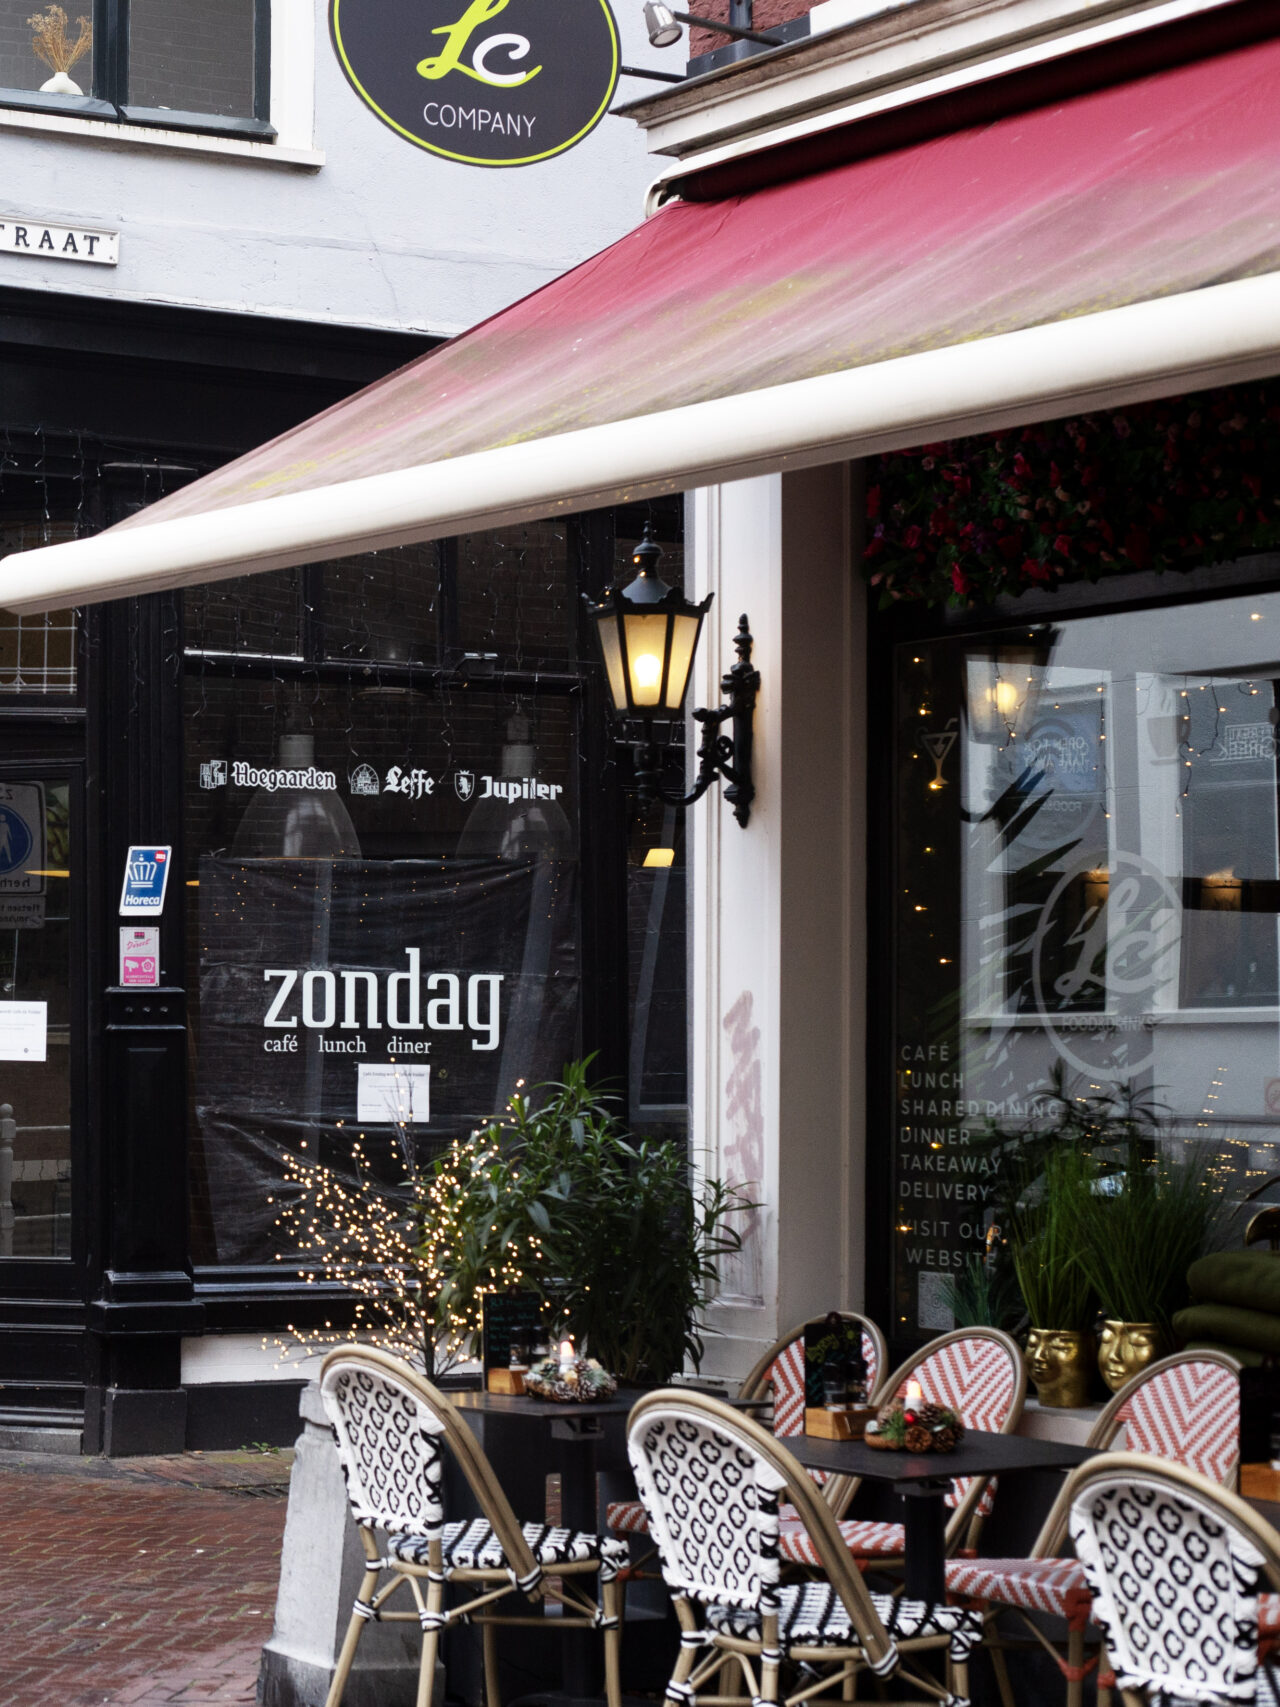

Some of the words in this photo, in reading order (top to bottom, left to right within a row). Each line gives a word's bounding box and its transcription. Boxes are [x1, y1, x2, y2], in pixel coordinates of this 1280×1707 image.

[423, 102, 536, 138] COMPANY
[231, 761, 337, 792] Hoegaarden
[382, 765, 435, 799] Leffe
[478, 775, 563, 804] Jupiler
[125, 894, 161, 906] Horeca
[263, 947, 505, 1051] zondag
[263, 1034, 299, 1052] café
[318, 1034, 368, 1053] lunch
[386, 1035, 432, 1054] diner
[900, 1041, 950, 1062] CAFÉ
[900, 1072, 964, 1089] LUNCH
[901, 1100, 979, 1117] SHARED
[986, 1102, 1060, 1119] DINING
[900, 1127, 971, 1145] DINNER
[901, 1154, 1002, 1174] TAKEAWAY
[899, 1181, 990, 1201] DELIVERY
[900, 1219, 950, 1237] VISIT
[959, 1222, 1002, 1241] OUR
[905, 1248, 997, 1268] WEBSITE
